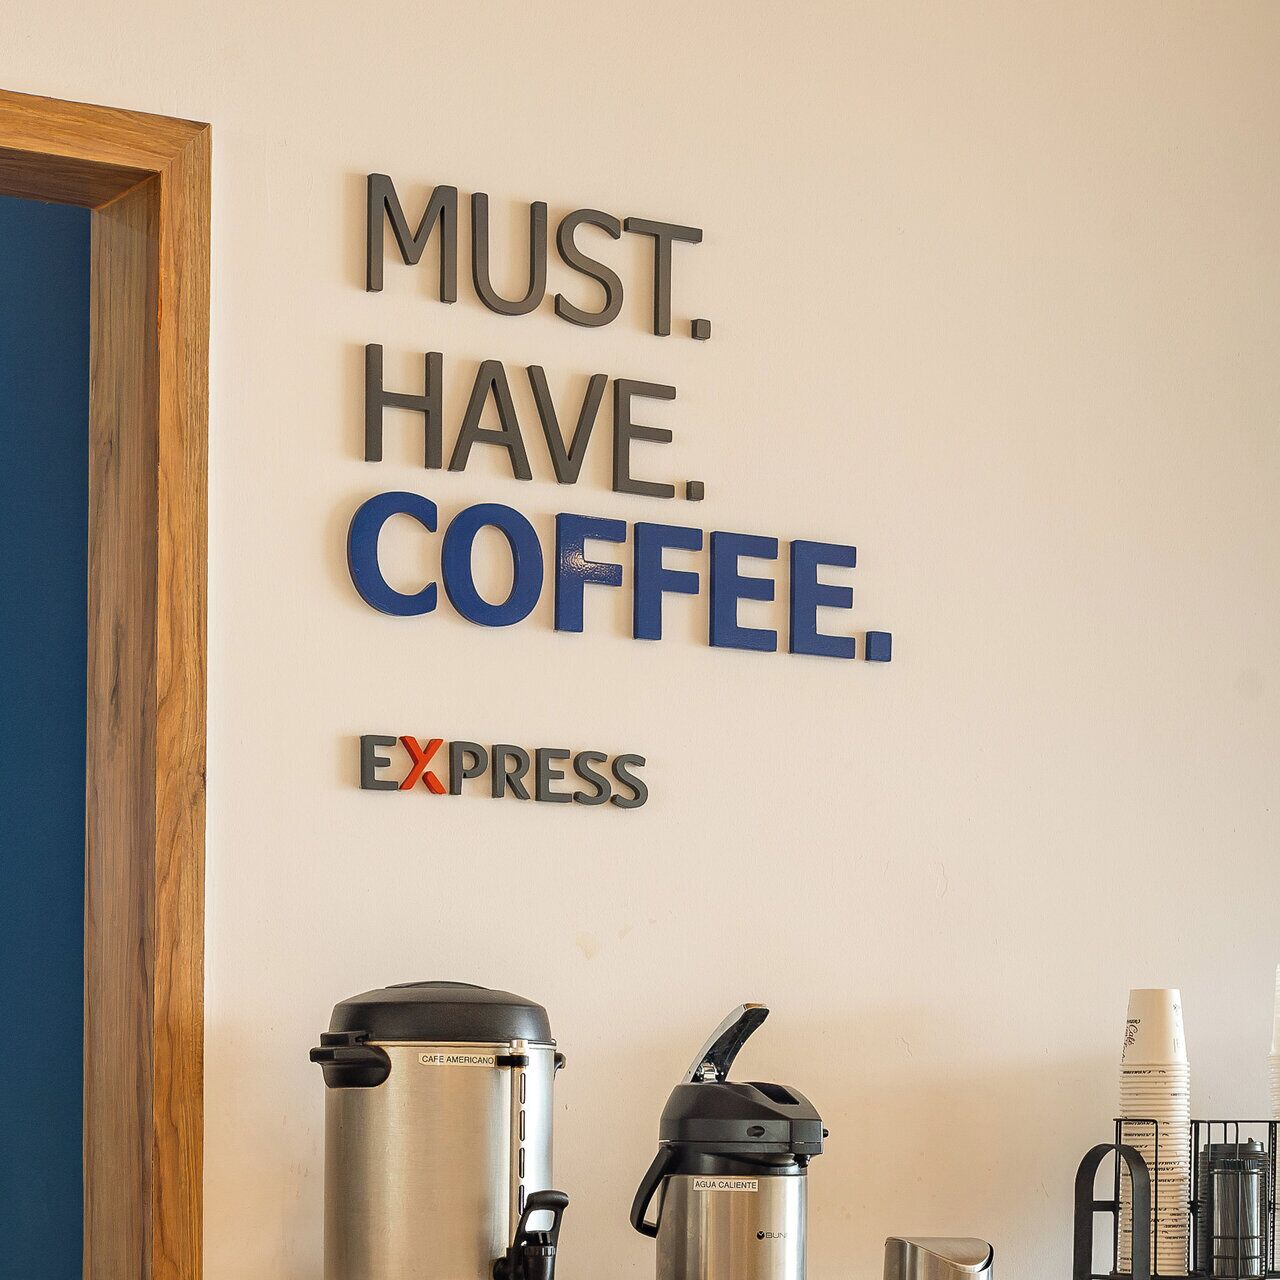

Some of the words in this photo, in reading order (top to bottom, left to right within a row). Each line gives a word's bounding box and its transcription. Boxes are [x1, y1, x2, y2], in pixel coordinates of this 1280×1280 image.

[366, 172, 712, 340] MUST.
[363, 343, 706, 502] HAVE.
[347, 489, 893, 663] COFFEE.
[359, 734, 649, 809] EXPRESS
[421, 1055, 444, 1063] CAFE
[446, 1055, 495, 1065] AMERICANO
[695, 1180, 717, 1189] AGUA
[718, 1180, 757, 1189] CALIENTE
